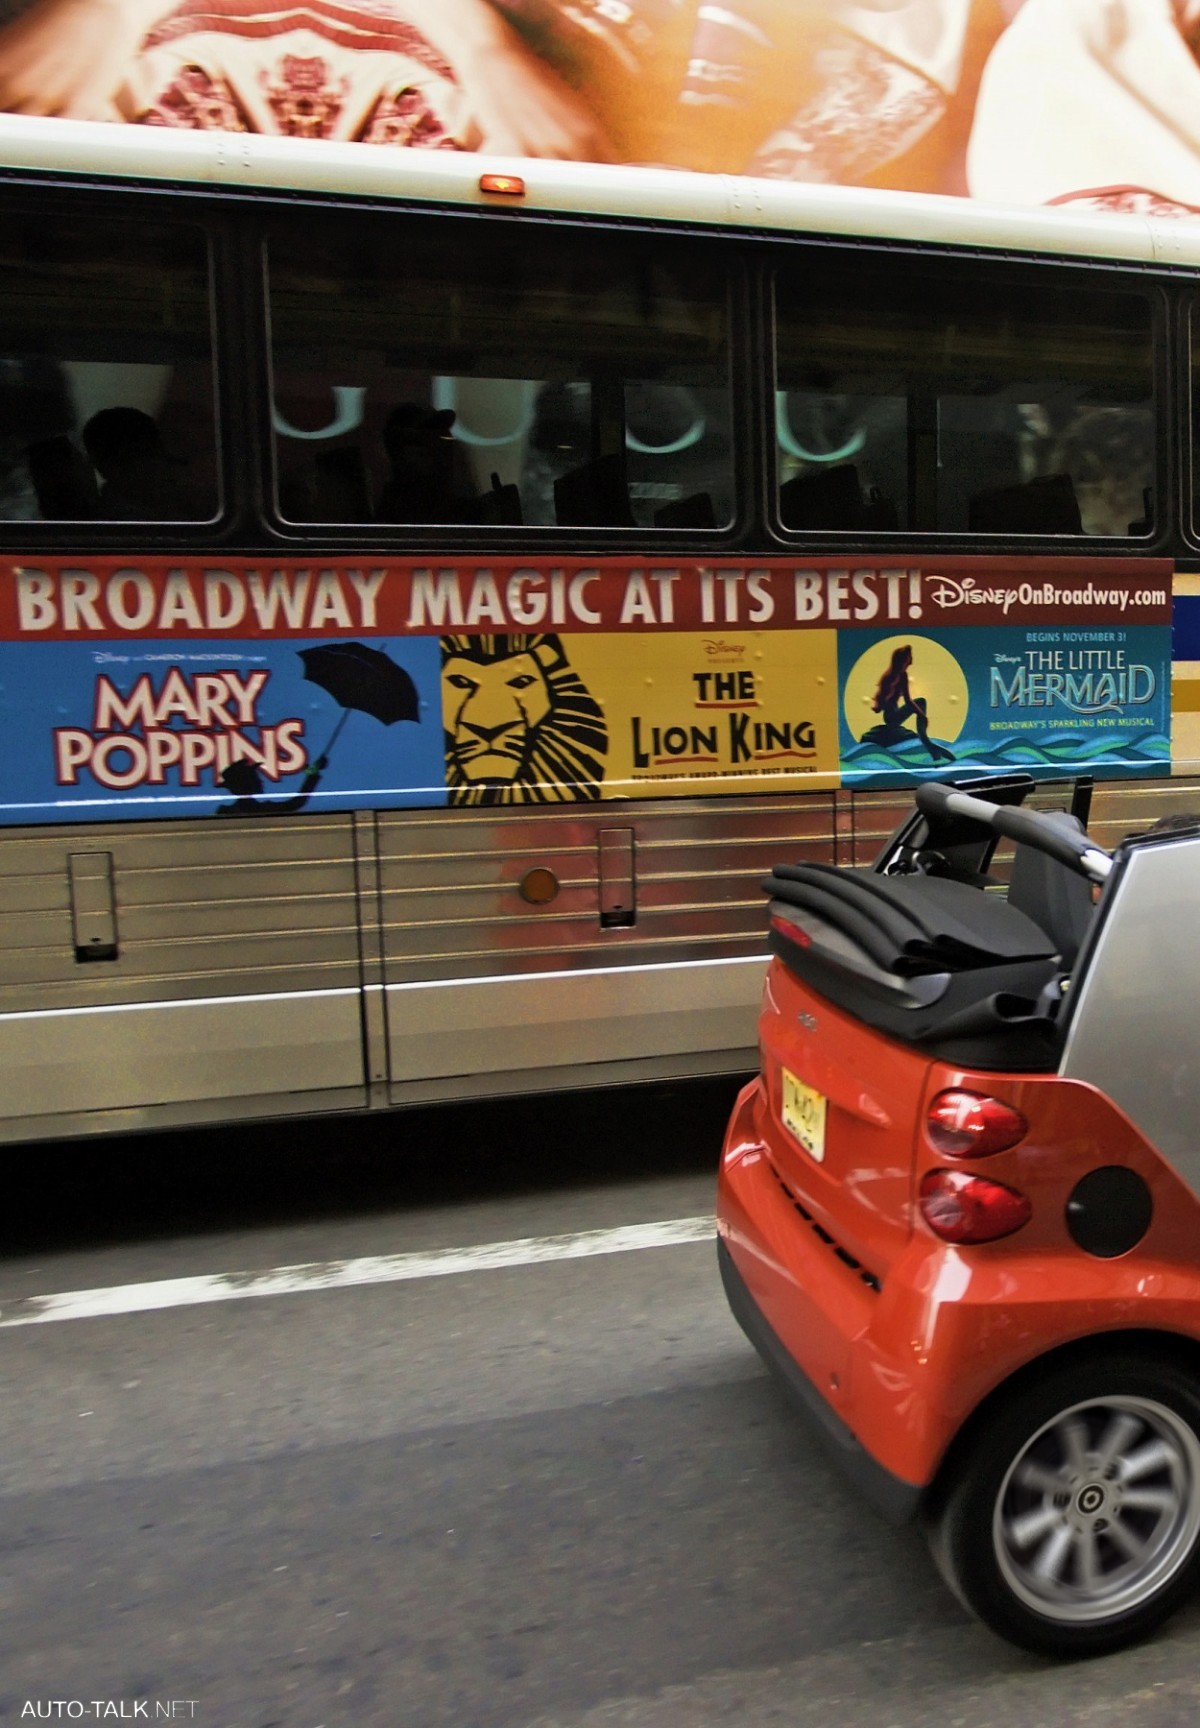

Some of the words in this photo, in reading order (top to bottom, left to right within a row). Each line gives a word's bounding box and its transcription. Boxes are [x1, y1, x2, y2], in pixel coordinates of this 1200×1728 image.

[16, 567, 388, 632] BROADWAY
[406, 567, 603, 629] MAGIC
[620, 568, 682, 625] AT
[700, 567, 775, 623] ITS
[793, 567, 924, 622] BEST!
[1025, 632, 1060, 642] BEGINS
[1063, 632, 1115, 642] NOVEMBER
[1025, 650, 1065, 671] THE
[1068, 650, 1126, 670] LITTLE
[94, 667, 270, 730] MARY
[692, 670, 756, 702] THE
[989, 664, 1157, 711] MERMAID
[631, 716, 719, 769] LION
[729, 712, 816, 764] KING
[1048, 718, 1095, 729] SPARKLING
[1096, 718, 1117, 727] NEW
[1118, 717, 1155, 728] MUSICAL
[55, 718, 307, 789] POPPINS
